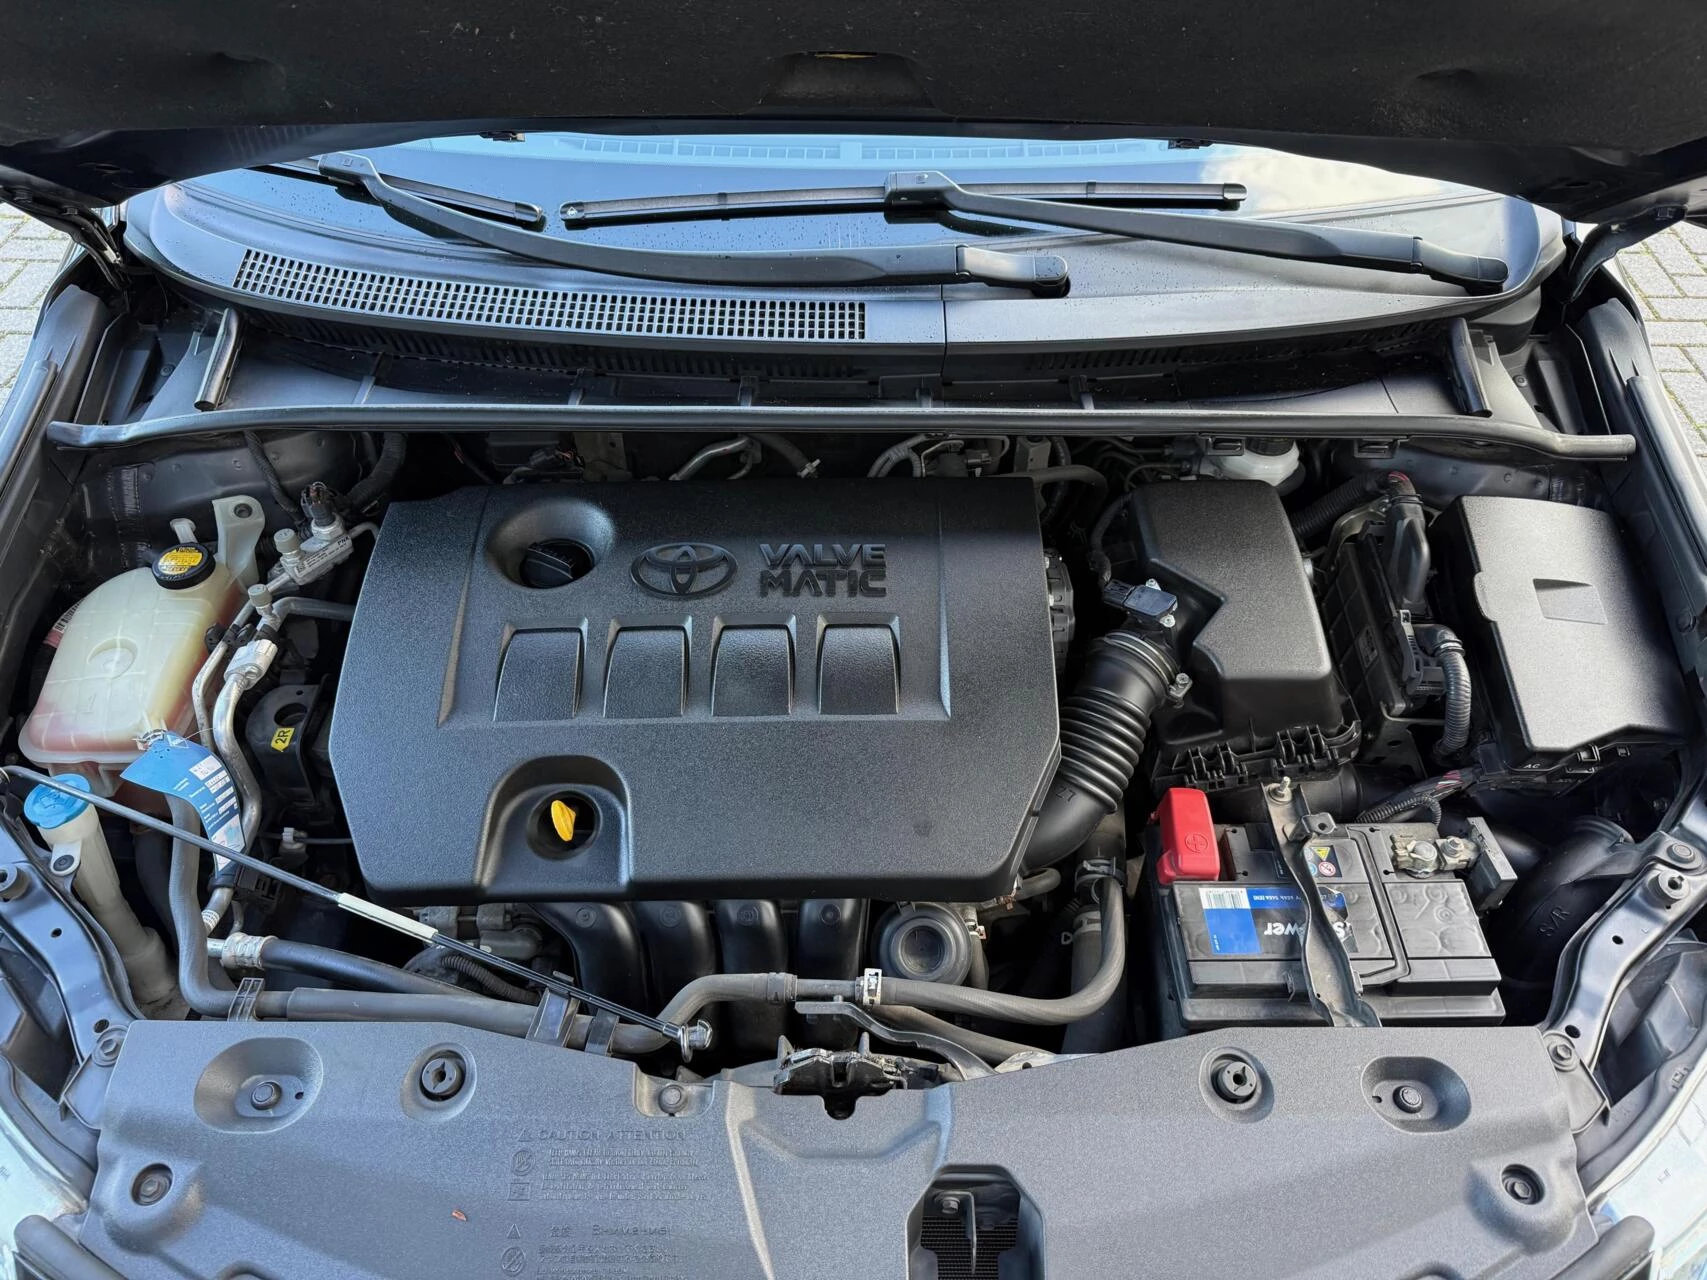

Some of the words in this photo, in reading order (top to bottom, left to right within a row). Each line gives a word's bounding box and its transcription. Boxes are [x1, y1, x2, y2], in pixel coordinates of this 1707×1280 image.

[759, 543, 887, 570] VALVE
[759, 569, 887, 597] MATIC
[274, 729, 291, 744] 2R
[538, 1129, 600, 1141] CAUTION
[606, 1129, 686, 1141] ATTENTION
